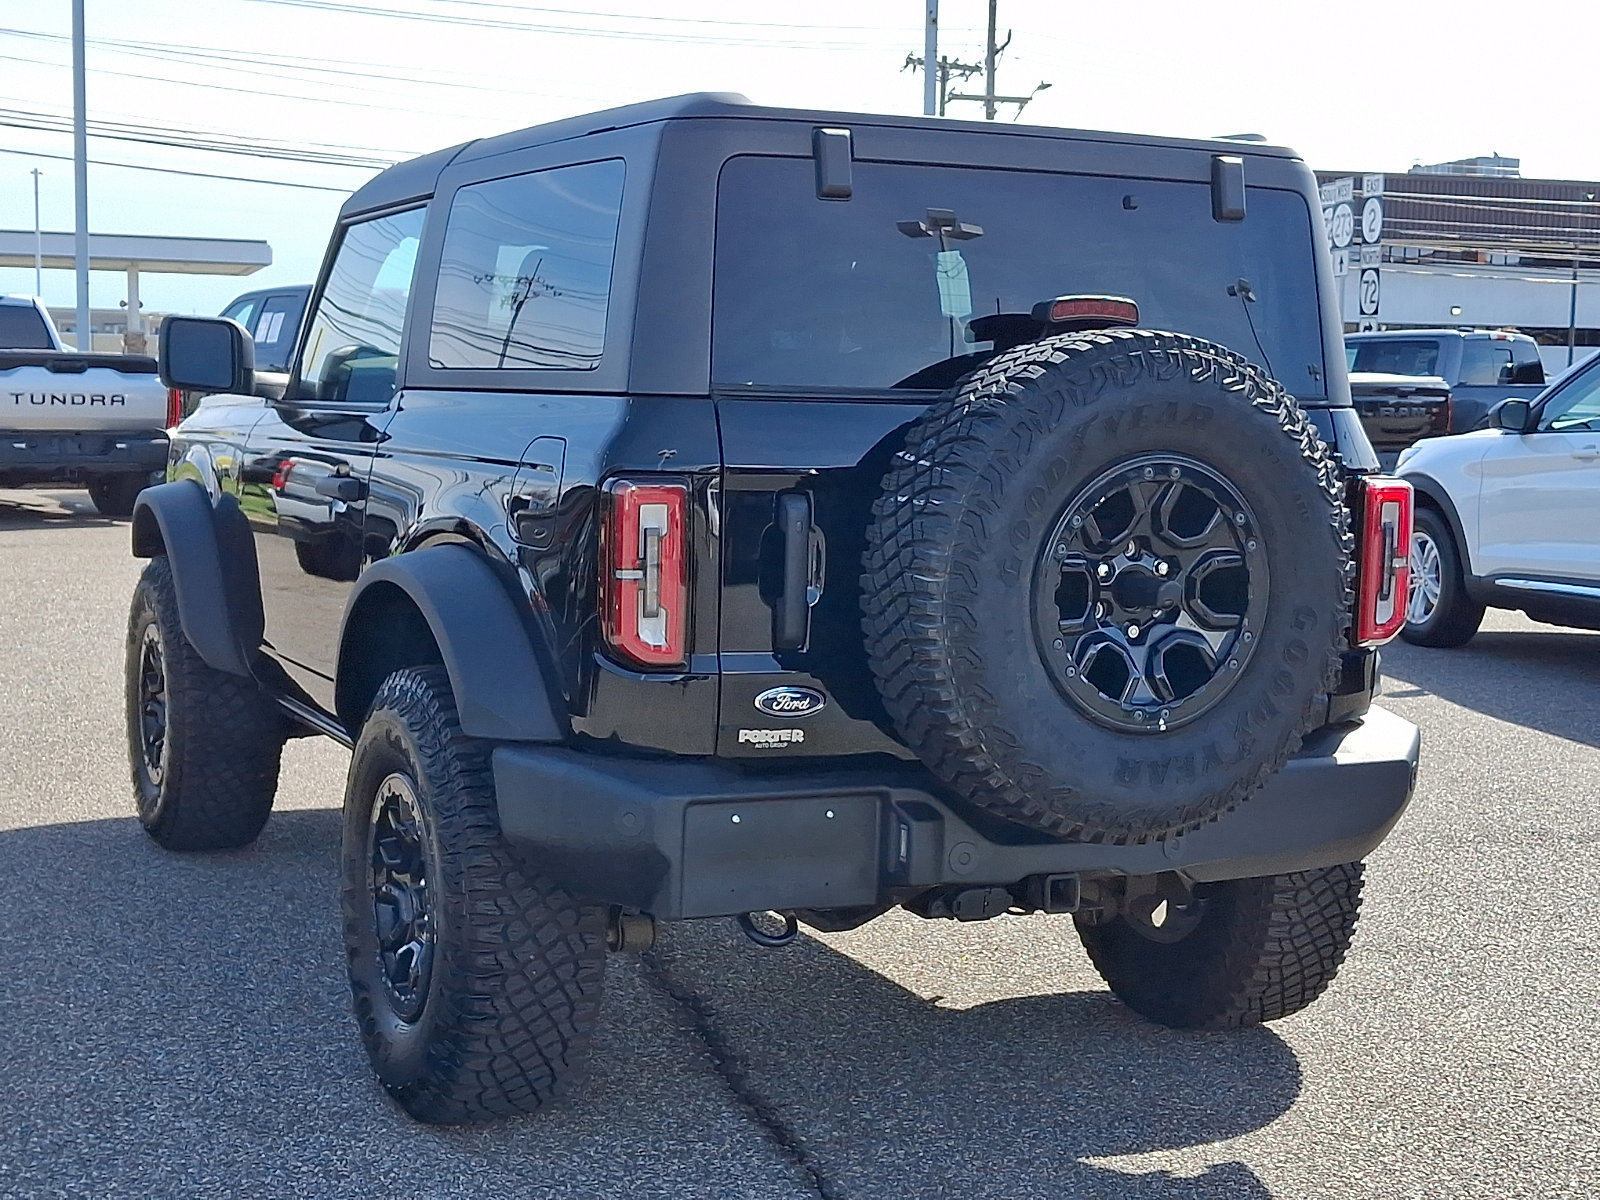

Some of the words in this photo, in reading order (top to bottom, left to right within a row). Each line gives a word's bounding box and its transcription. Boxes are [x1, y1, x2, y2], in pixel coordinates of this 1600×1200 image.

[1366, 177, 1380, 193] EAST
[1335, 212, 1352, 238] 273
[1368, 208, 1376, 233] 2
[1362, 280, 1377, 304] 72
[10, 392, 126, 406] TUNDRA
[1379, 407, 1427, 417] RAM
[772, 692, 810, 710] Ford
[738, 728, 805, 743] PORTER
